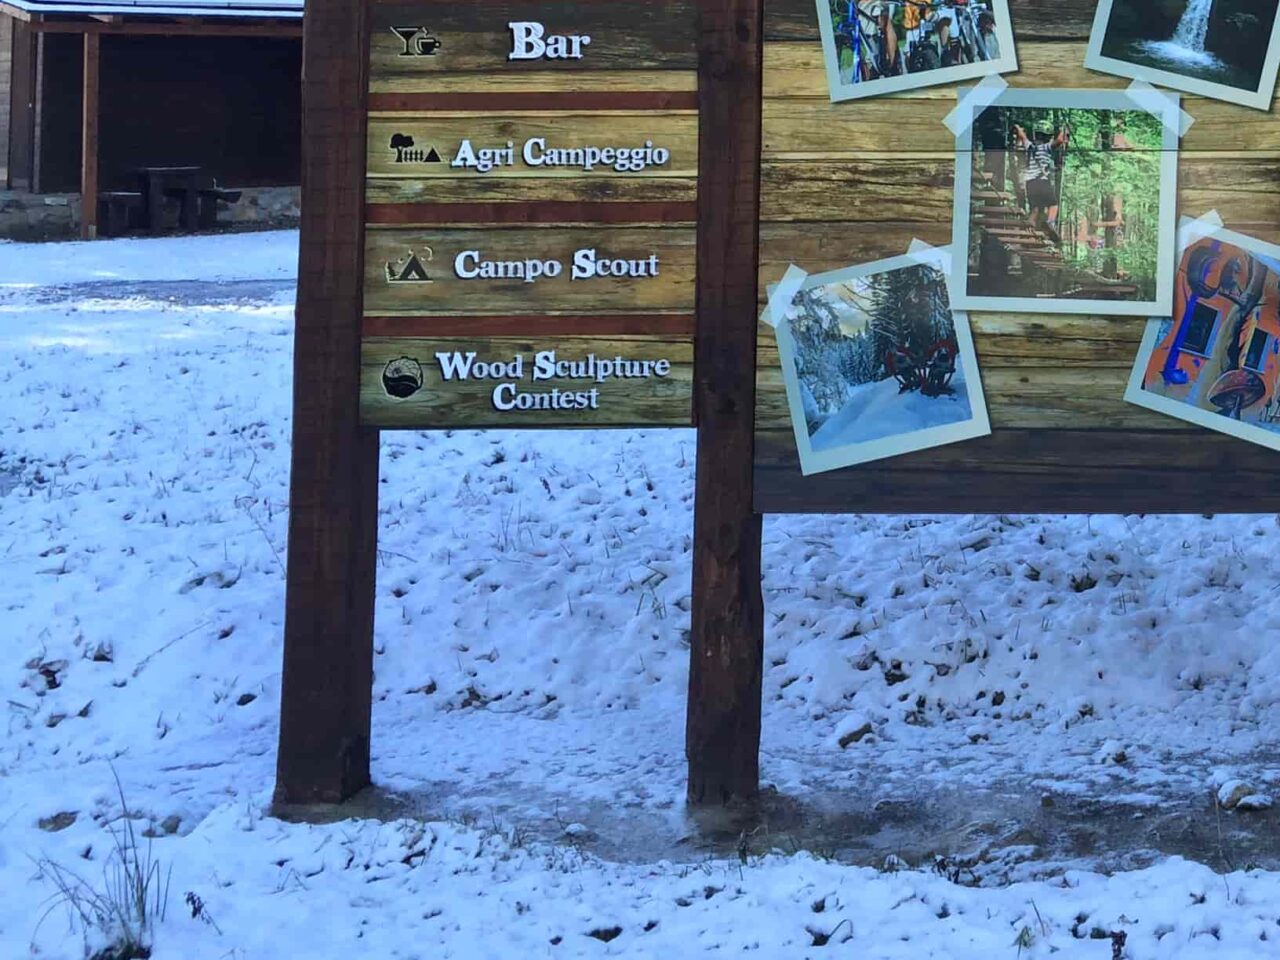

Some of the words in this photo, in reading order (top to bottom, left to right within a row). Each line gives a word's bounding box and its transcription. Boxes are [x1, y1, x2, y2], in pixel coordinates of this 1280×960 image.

[508, 21, 592, 60] Bar
[451, 139, 514, 171] Agri
[523, 138, 670, 170] Campeggio
[454, 250, 562, 282] Campo
[571, 249, 660, 280] Scout
[435, 351, 523, 380] Wood
[532, 350, 671, 382] Sculpture
[492, 383, 600, 411] Contest
